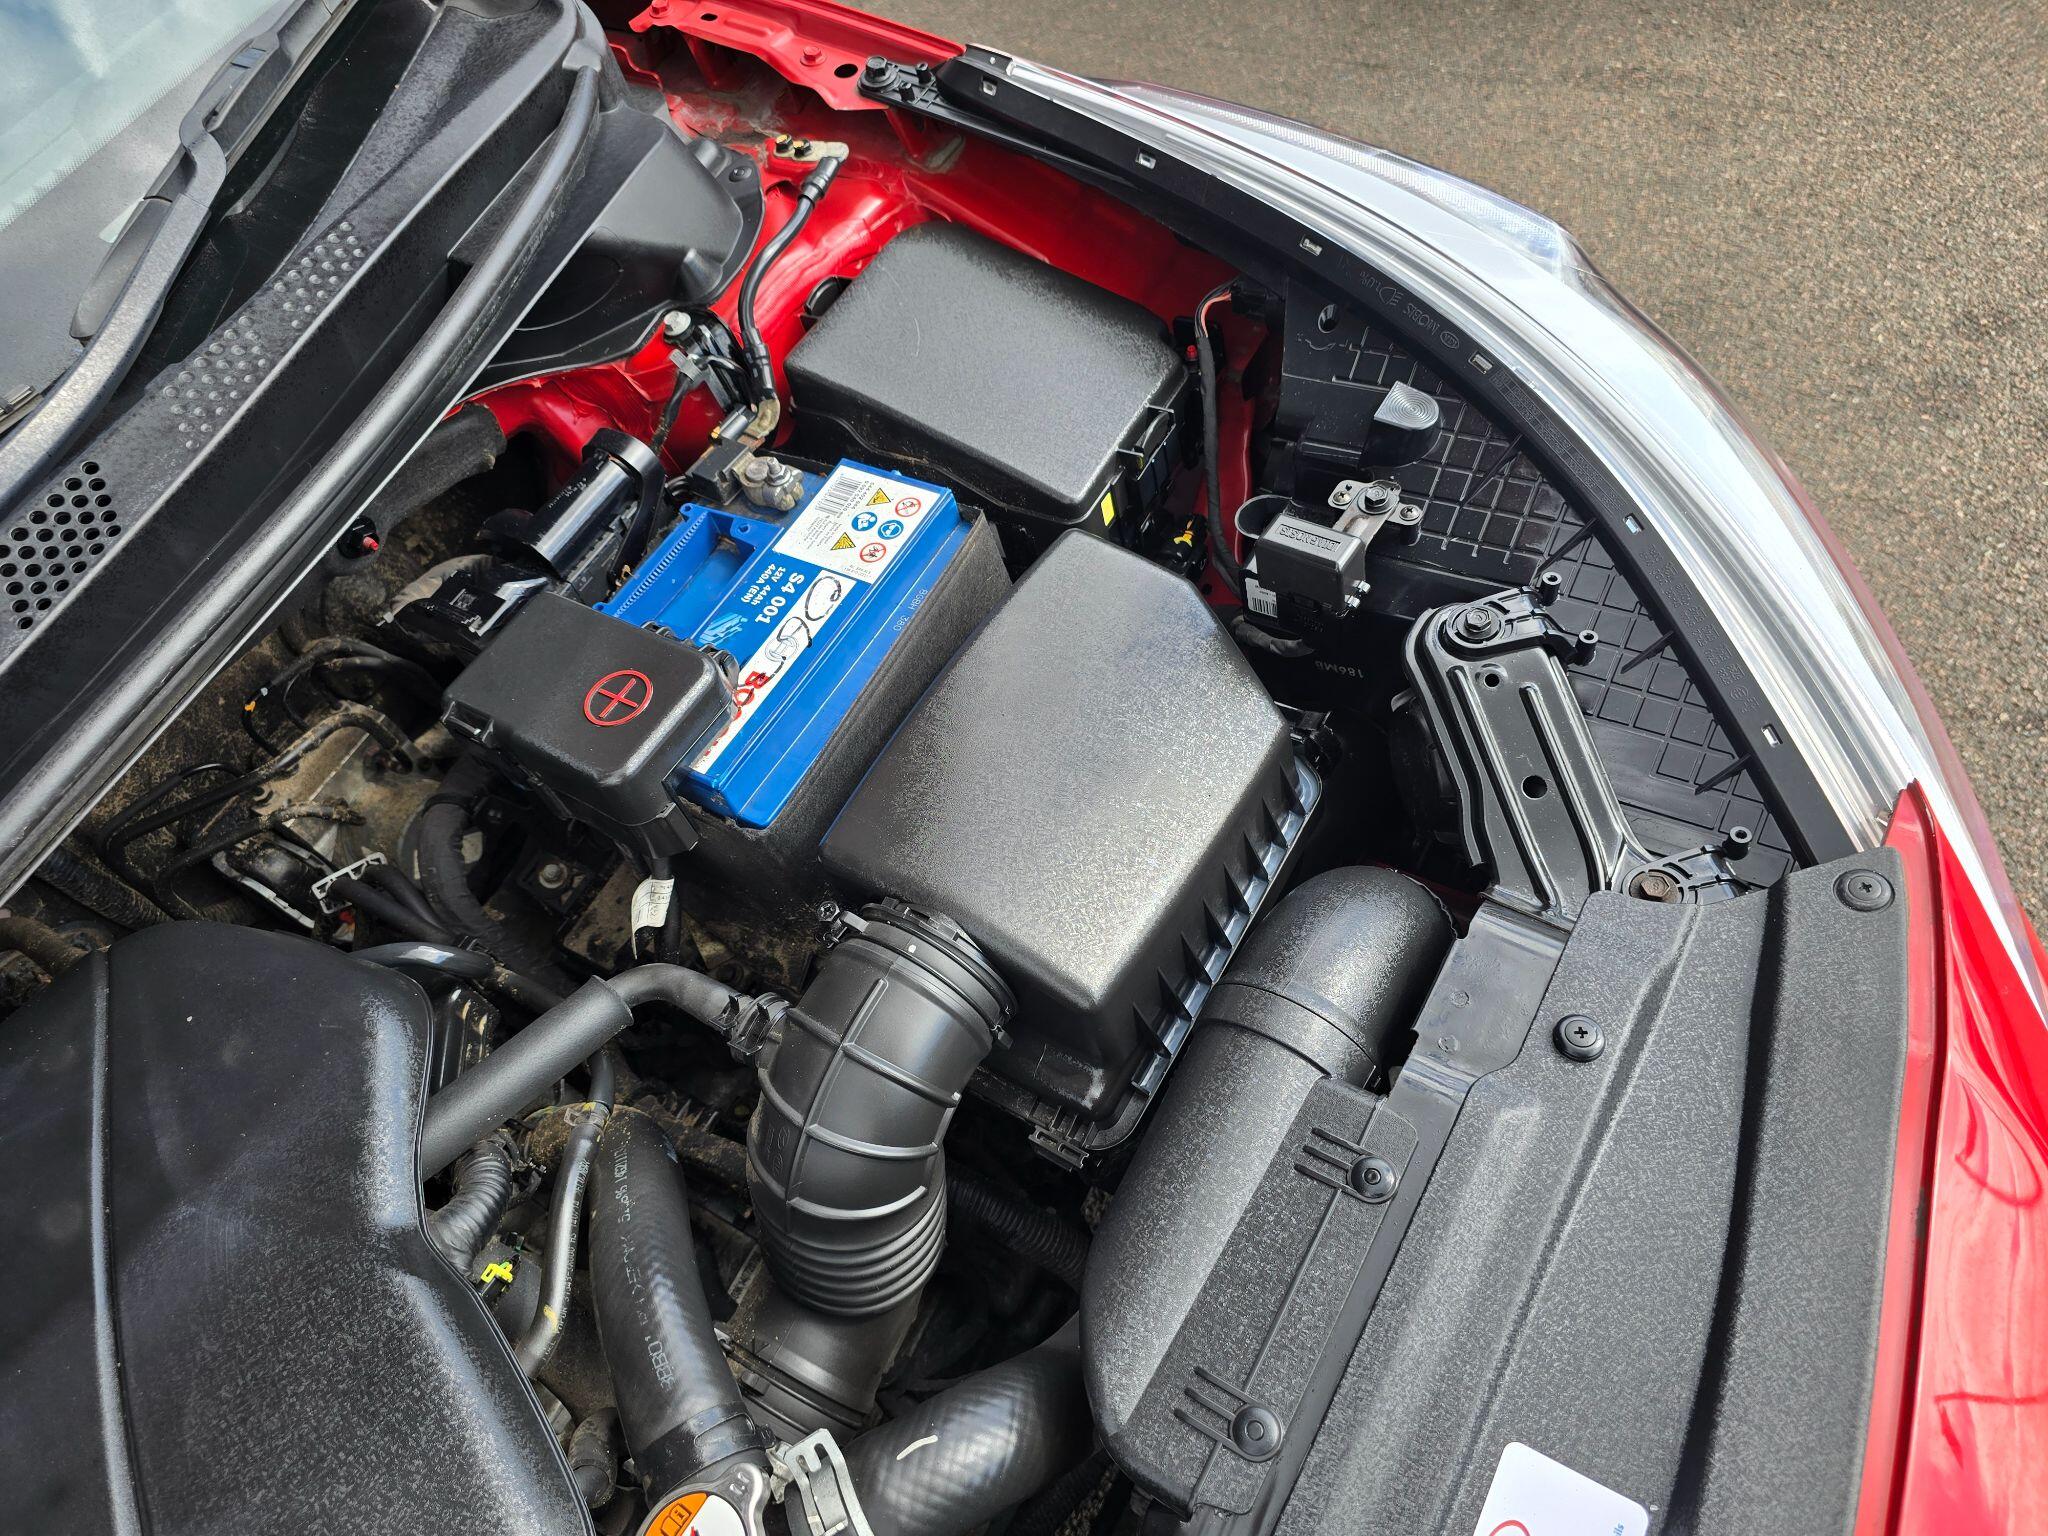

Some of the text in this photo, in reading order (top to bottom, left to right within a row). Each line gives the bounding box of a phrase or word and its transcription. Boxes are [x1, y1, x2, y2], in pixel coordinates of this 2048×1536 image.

[1279, 525, 1338, 552] DIAGNOSIS
[740, 563, 776, 603] 440A (EN)
[751, 566, 786, 606] 12V 44Ah
[755, 572, 805, 624] S4 001
